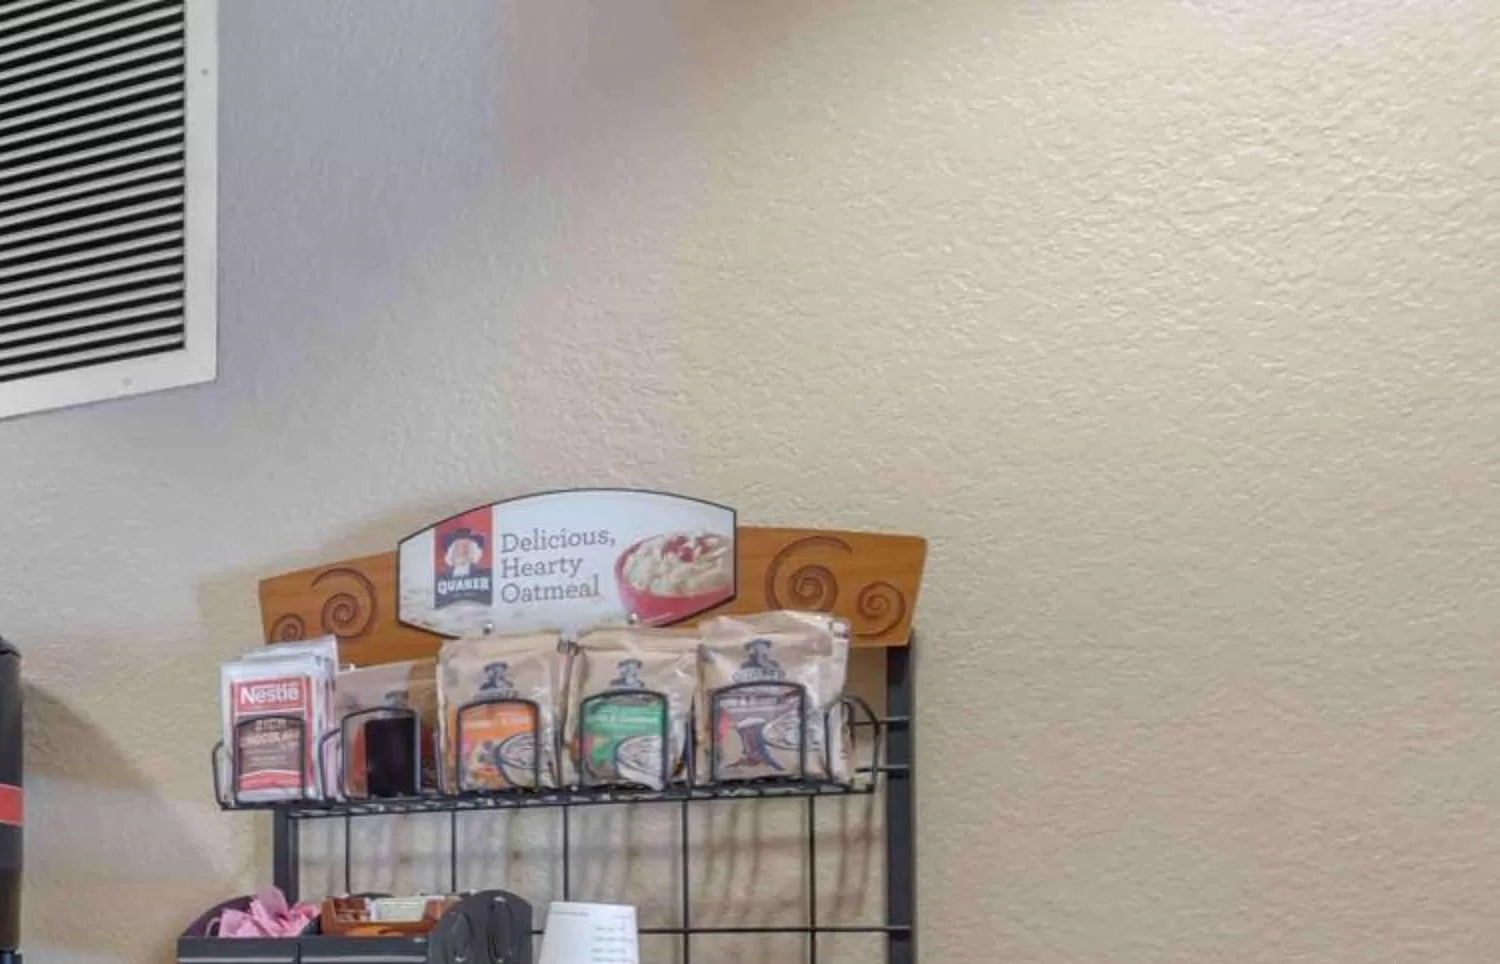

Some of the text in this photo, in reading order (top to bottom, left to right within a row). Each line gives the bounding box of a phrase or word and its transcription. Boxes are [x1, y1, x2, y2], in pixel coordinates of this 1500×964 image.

[500, 527, 616, 554] Delicious,
[500, 556, 585, 580] Hearty
[437, 577, 489, 596] QUAKER
[500, 574, 600, 604] Oatmeal
